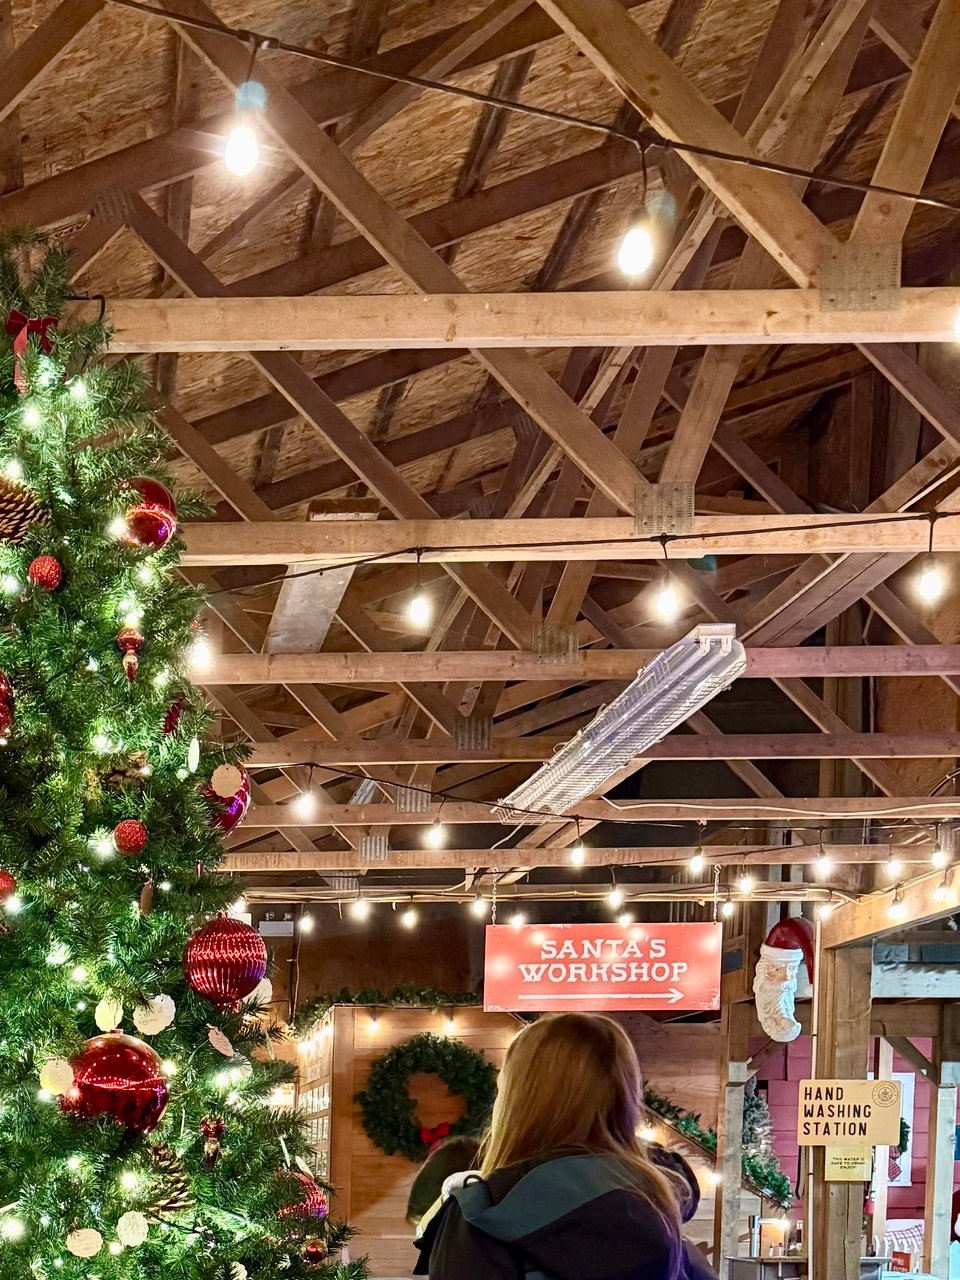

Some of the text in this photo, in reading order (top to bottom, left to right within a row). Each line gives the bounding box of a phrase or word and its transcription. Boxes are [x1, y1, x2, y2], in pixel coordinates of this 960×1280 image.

[540, 934, 667, 960] SANTA'S
[518, 961, 689, 983] WORKSHOP
[804, 1086, 844, 1101] HAND
[803, 1104, 872, 1118] WASHING
[803, 1122, 867, 1136] STATION
